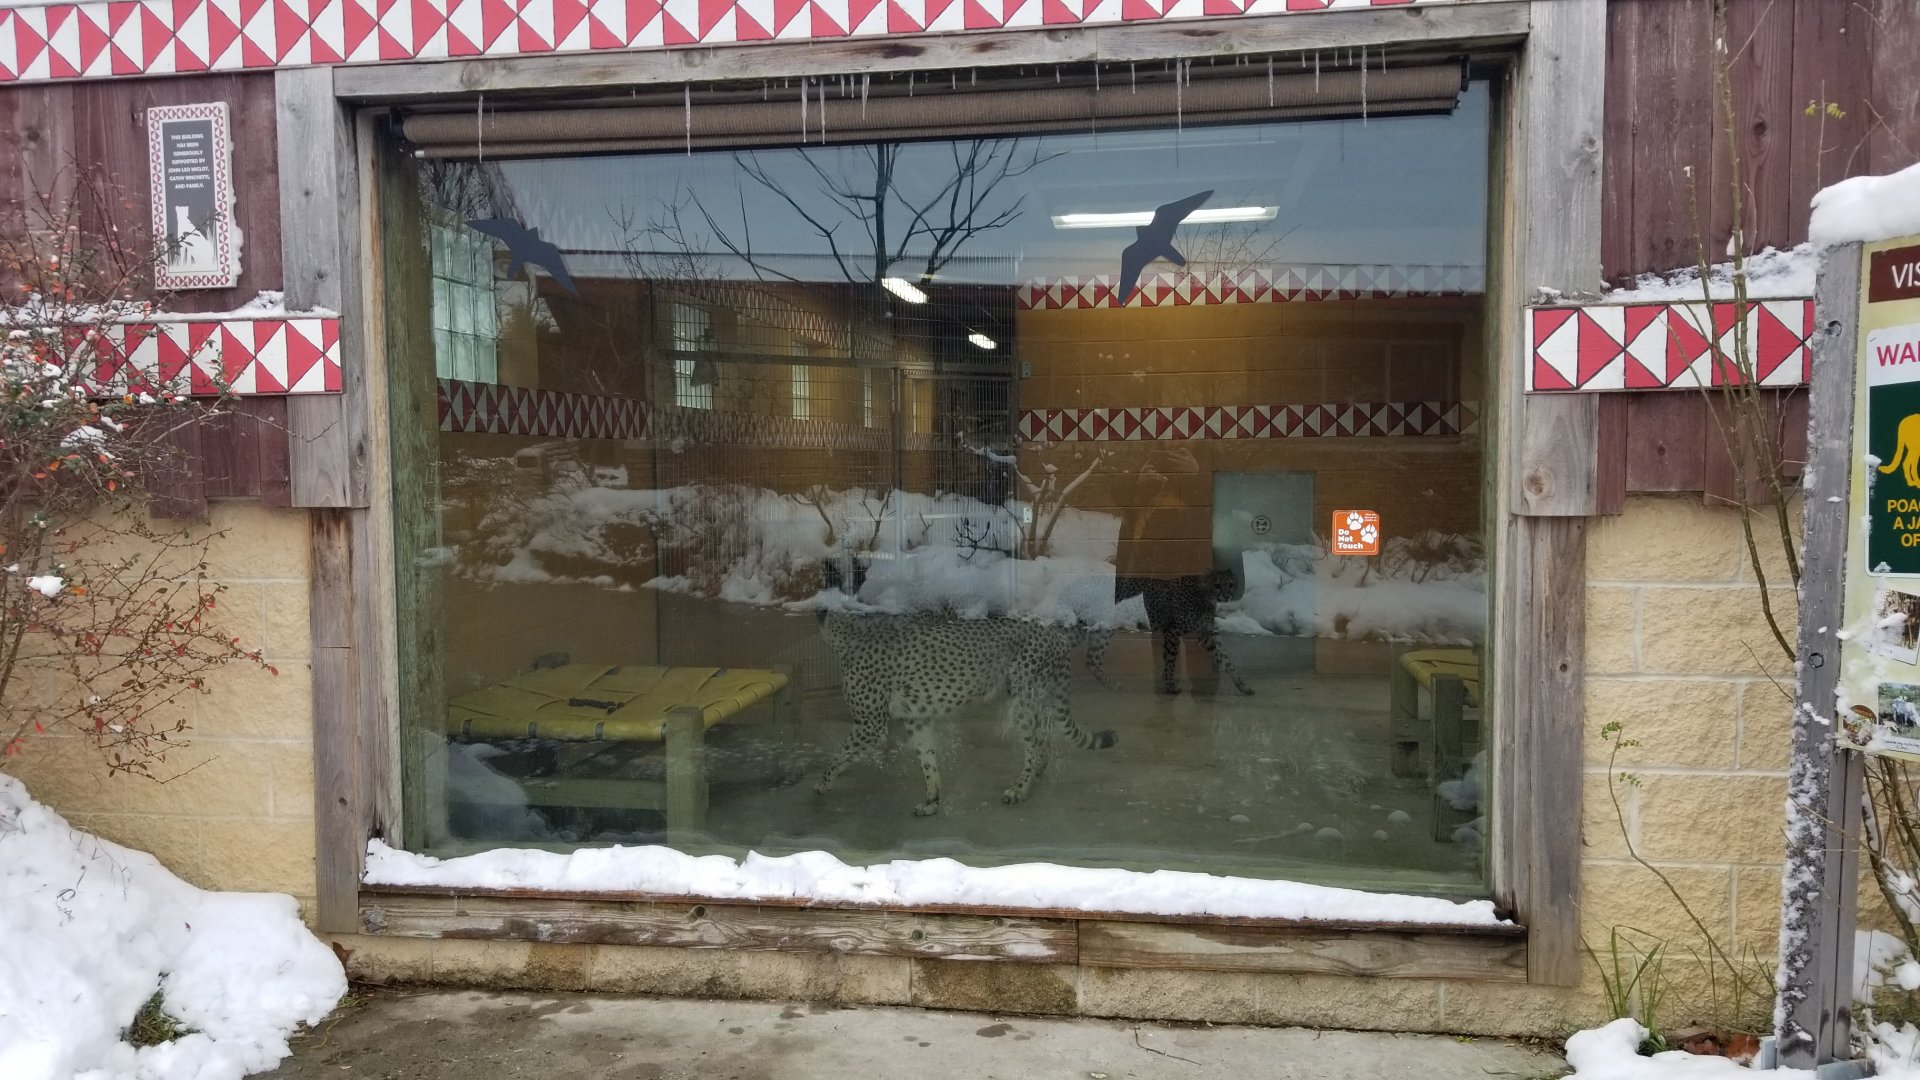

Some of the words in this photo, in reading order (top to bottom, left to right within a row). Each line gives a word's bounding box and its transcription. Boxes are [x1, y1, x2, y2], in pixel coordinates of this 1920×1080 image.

[1876, 341, 1920, 367] WA
[1887, 498, 1920, 513] POA
[1893, 516, 1905, 530] A
